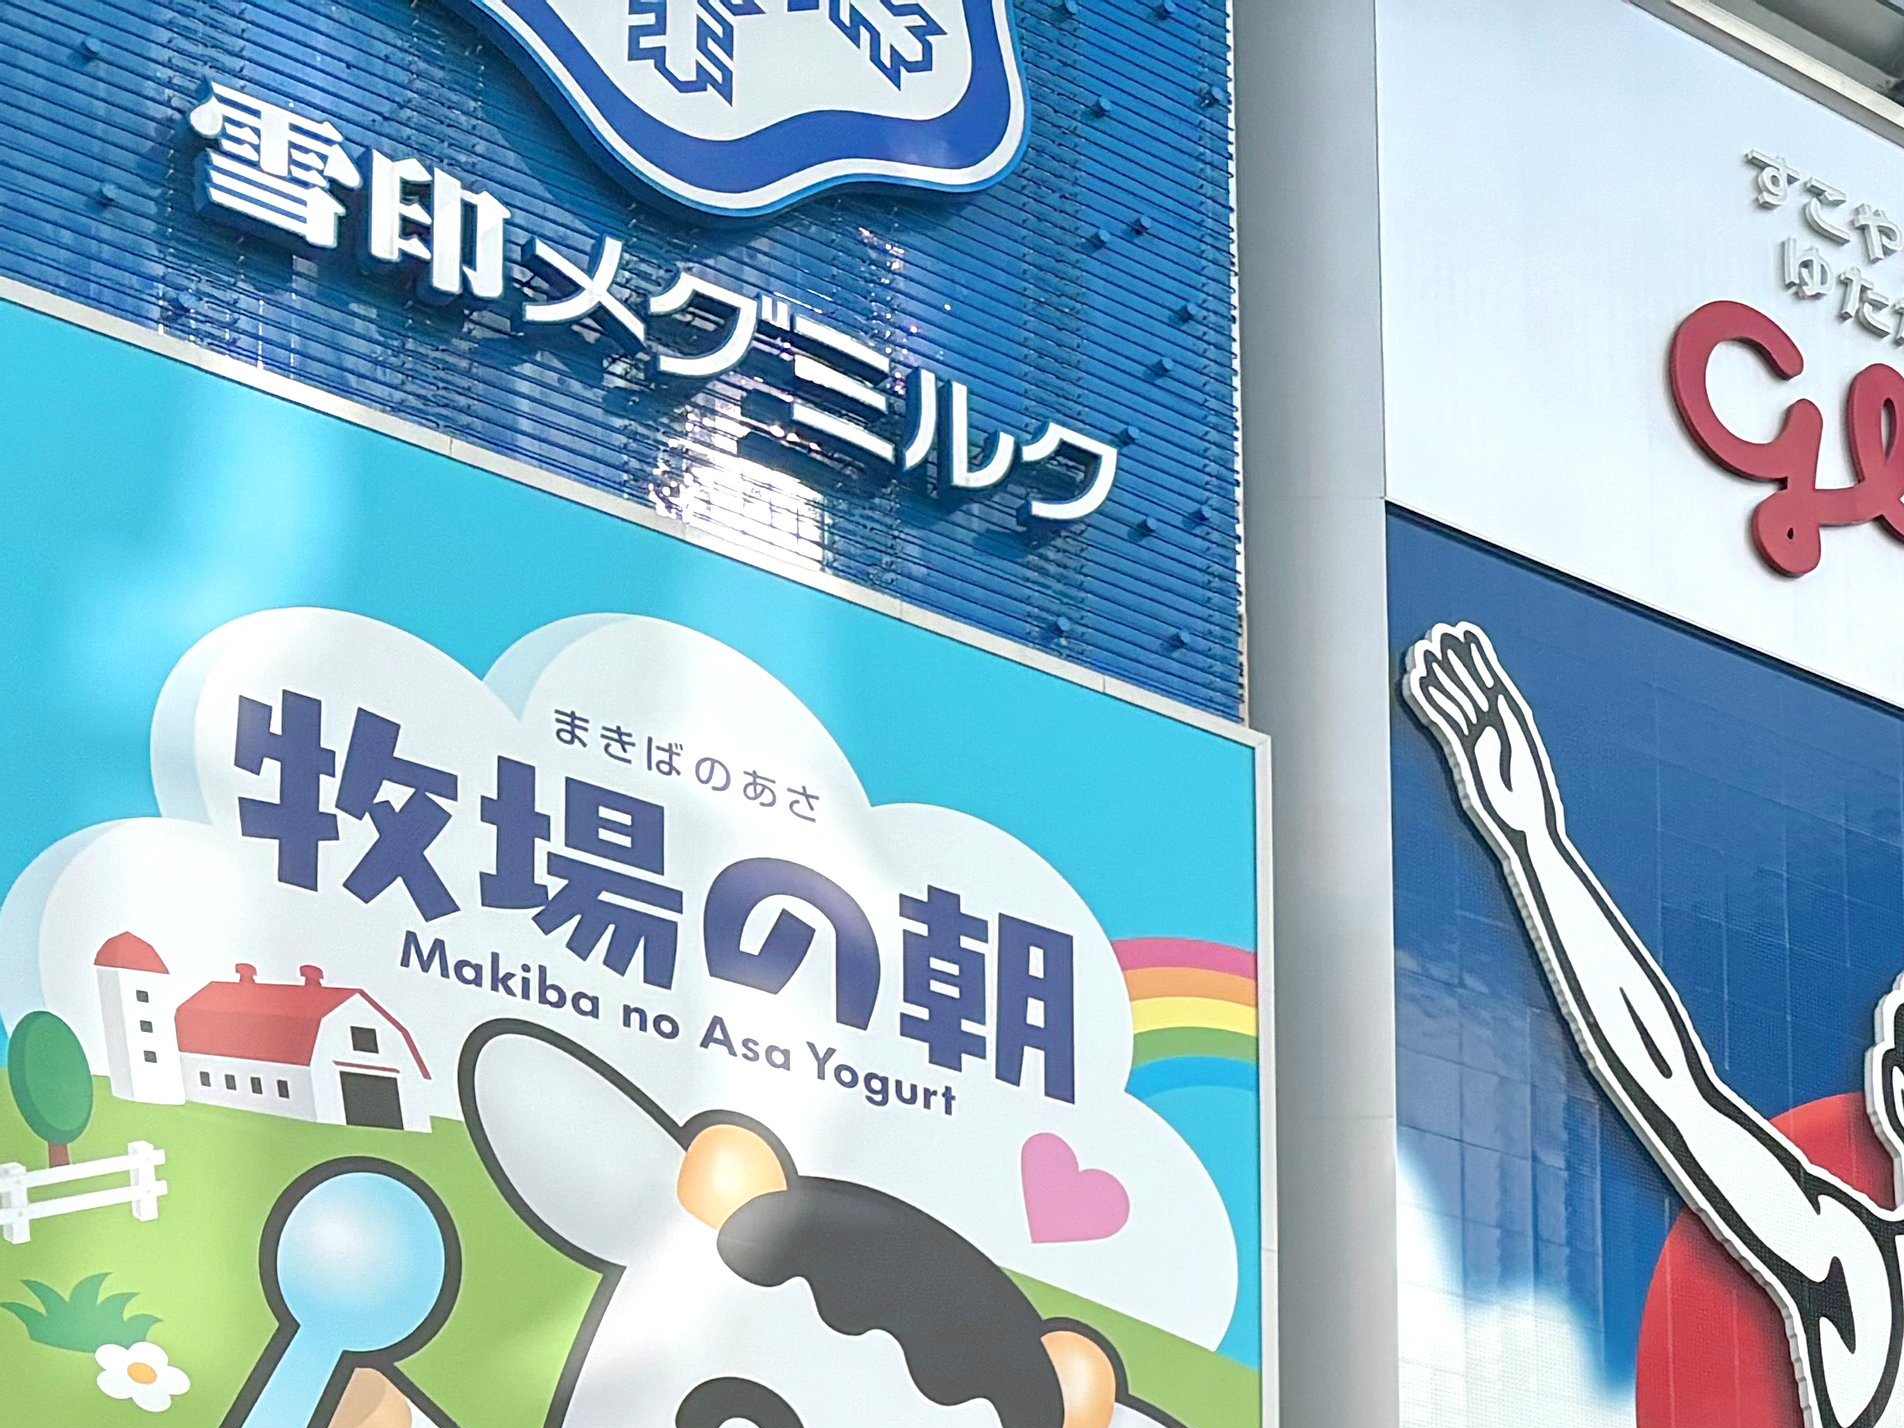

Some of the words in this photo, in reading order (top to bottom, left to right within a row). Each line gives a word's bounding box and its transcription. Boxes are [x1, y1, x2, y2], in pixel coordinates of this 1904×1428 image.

[190, 81, 1117, 519] 雪印メグミルク
[232, 688, 1075, 1104] 牧場の朝
[552, 707, 821, 823] まきばのあさ
[399, 929, 602, 1020] Makiba
[621, 1002, 681, 1041] no
[699, 1015, 793, 1073] Asa
[806, 1046, 958, 1118] Yogurt
